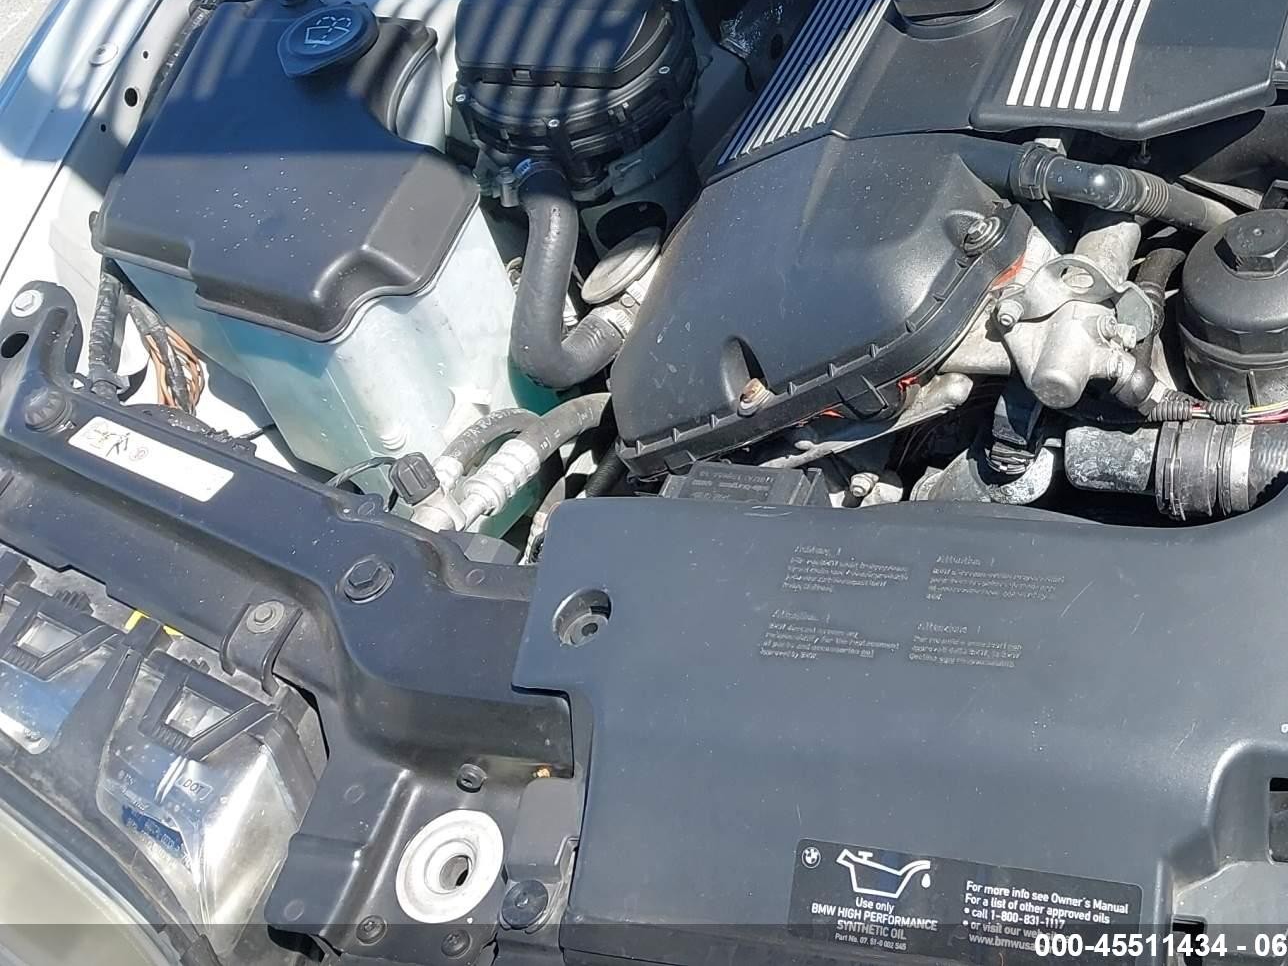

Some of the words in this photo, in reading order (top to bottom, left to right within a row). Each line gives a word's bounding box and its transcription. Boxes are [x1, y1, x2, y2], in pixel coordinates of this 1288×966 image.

[182, 778, 205, 794] DOT
[856, 896, 874, 908] Use
[875, 902, 894, 914] only
[966, 880, 983, 892] For
[984, 884, 1010, 896] more
[1012, 887, 1030, 899] info
[1031, 892, 1049, 902] see
[1093, 899, 1128, 914] Manual
[811, 902, 836, 916] BMW
[838, 907, 862, 920] HIGH
[863, 911, 938, 931] PERFORMANCE
[965, 893, 981, 904] For
[991, 896, 1006, 909] list
[1008, 899, 1018, 910] of
[1019, 900, 1045, 914] other
[1046, 906, 1091, 921] approved
[1092, 912, 1110, 924] oils
[970, 921, 981, 930] or
[982, 922, 1002, 933] visit
[1004, 926, 1022, 936] our
[972, 908, 988, 919] call
[991, 910, 1065, 930] 1-800-831-1117
[835, 933, 847, 941] Part
[836, 920, 889, 937] SYNTHETIC
[890, 928, 907, 940] OIL
